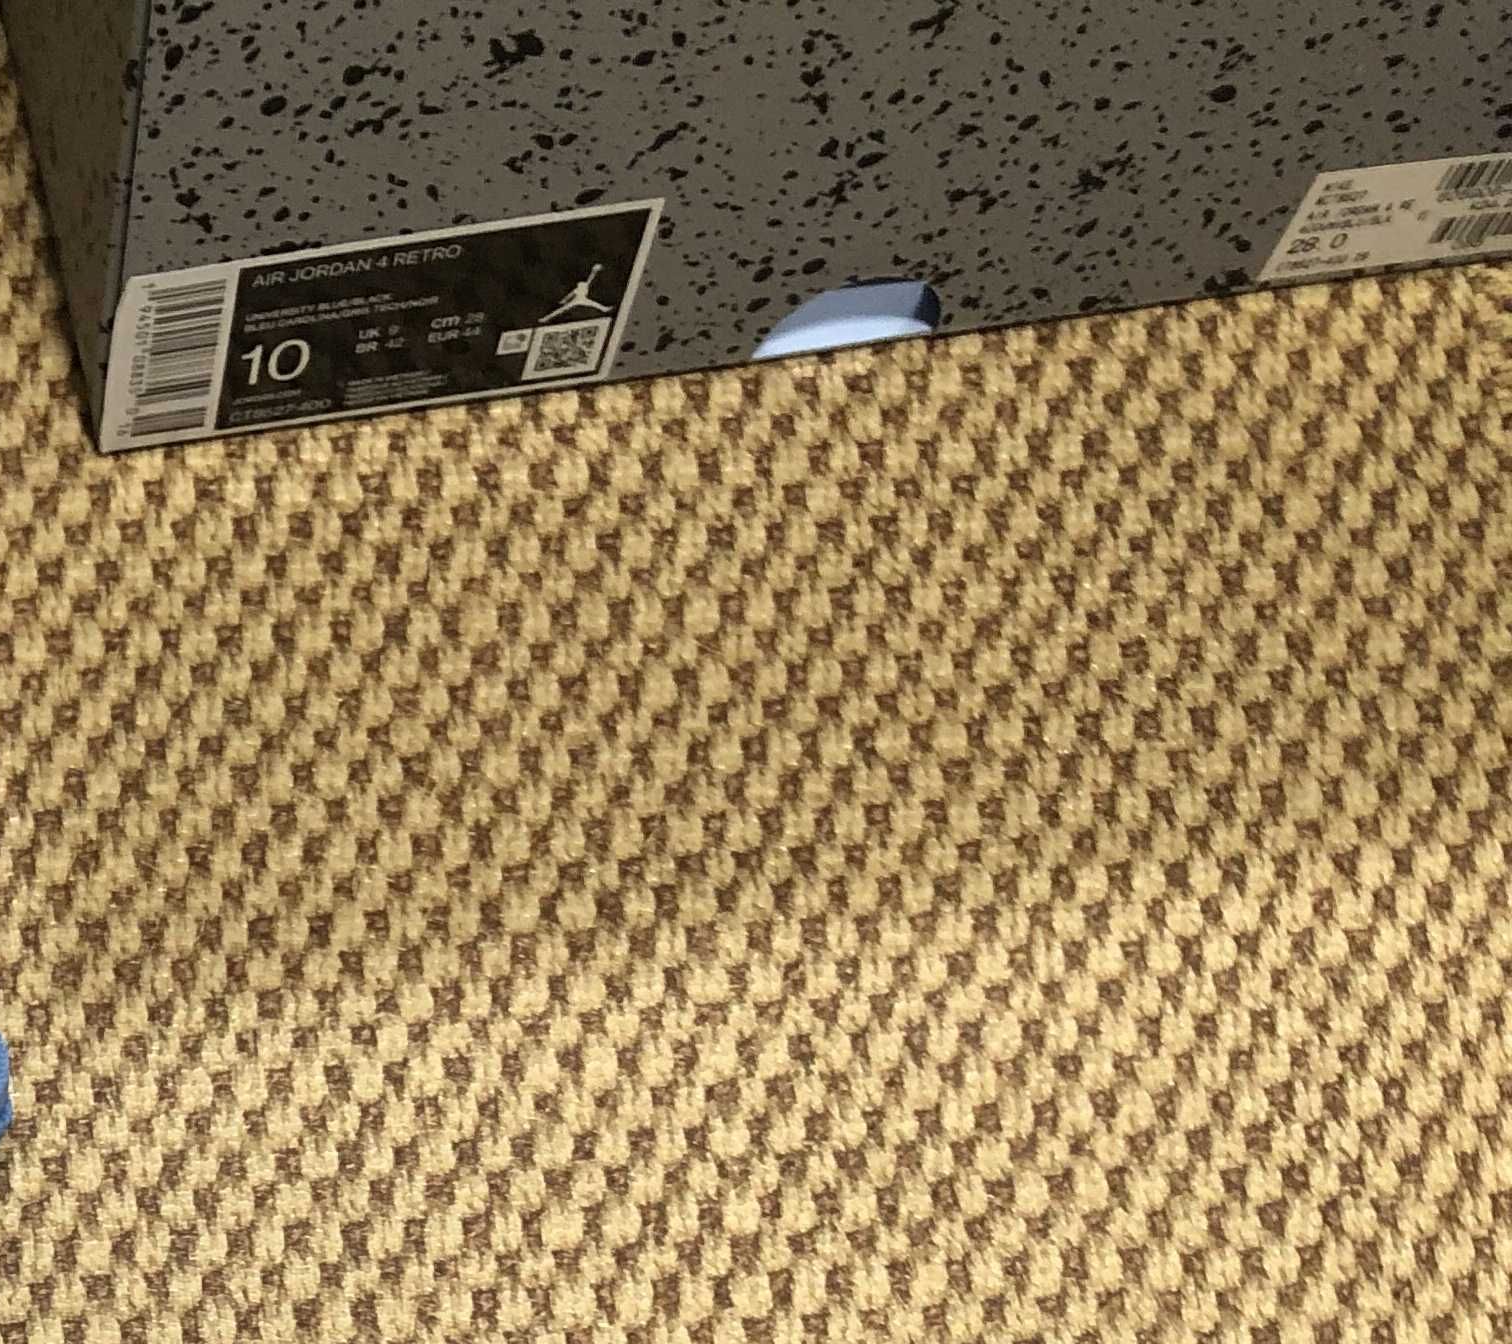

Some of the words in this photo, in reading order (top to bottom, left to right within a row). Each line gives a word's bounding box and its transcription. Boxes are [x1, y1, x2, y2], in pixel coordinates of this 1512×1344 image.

[252, 270, 285, 288] AIR
[289, 258, 372, 283] JORDAN
[375, 255, 388, 269] 4
[392, 244, 463, 267] RETRO
[355, 340, 379, 354] BR
[427, 329, 460, 344] EUR
[358, 327, 381, 340] UK
[430, 315, 461, 329] cm
[241, 338, 311, 386] 10
